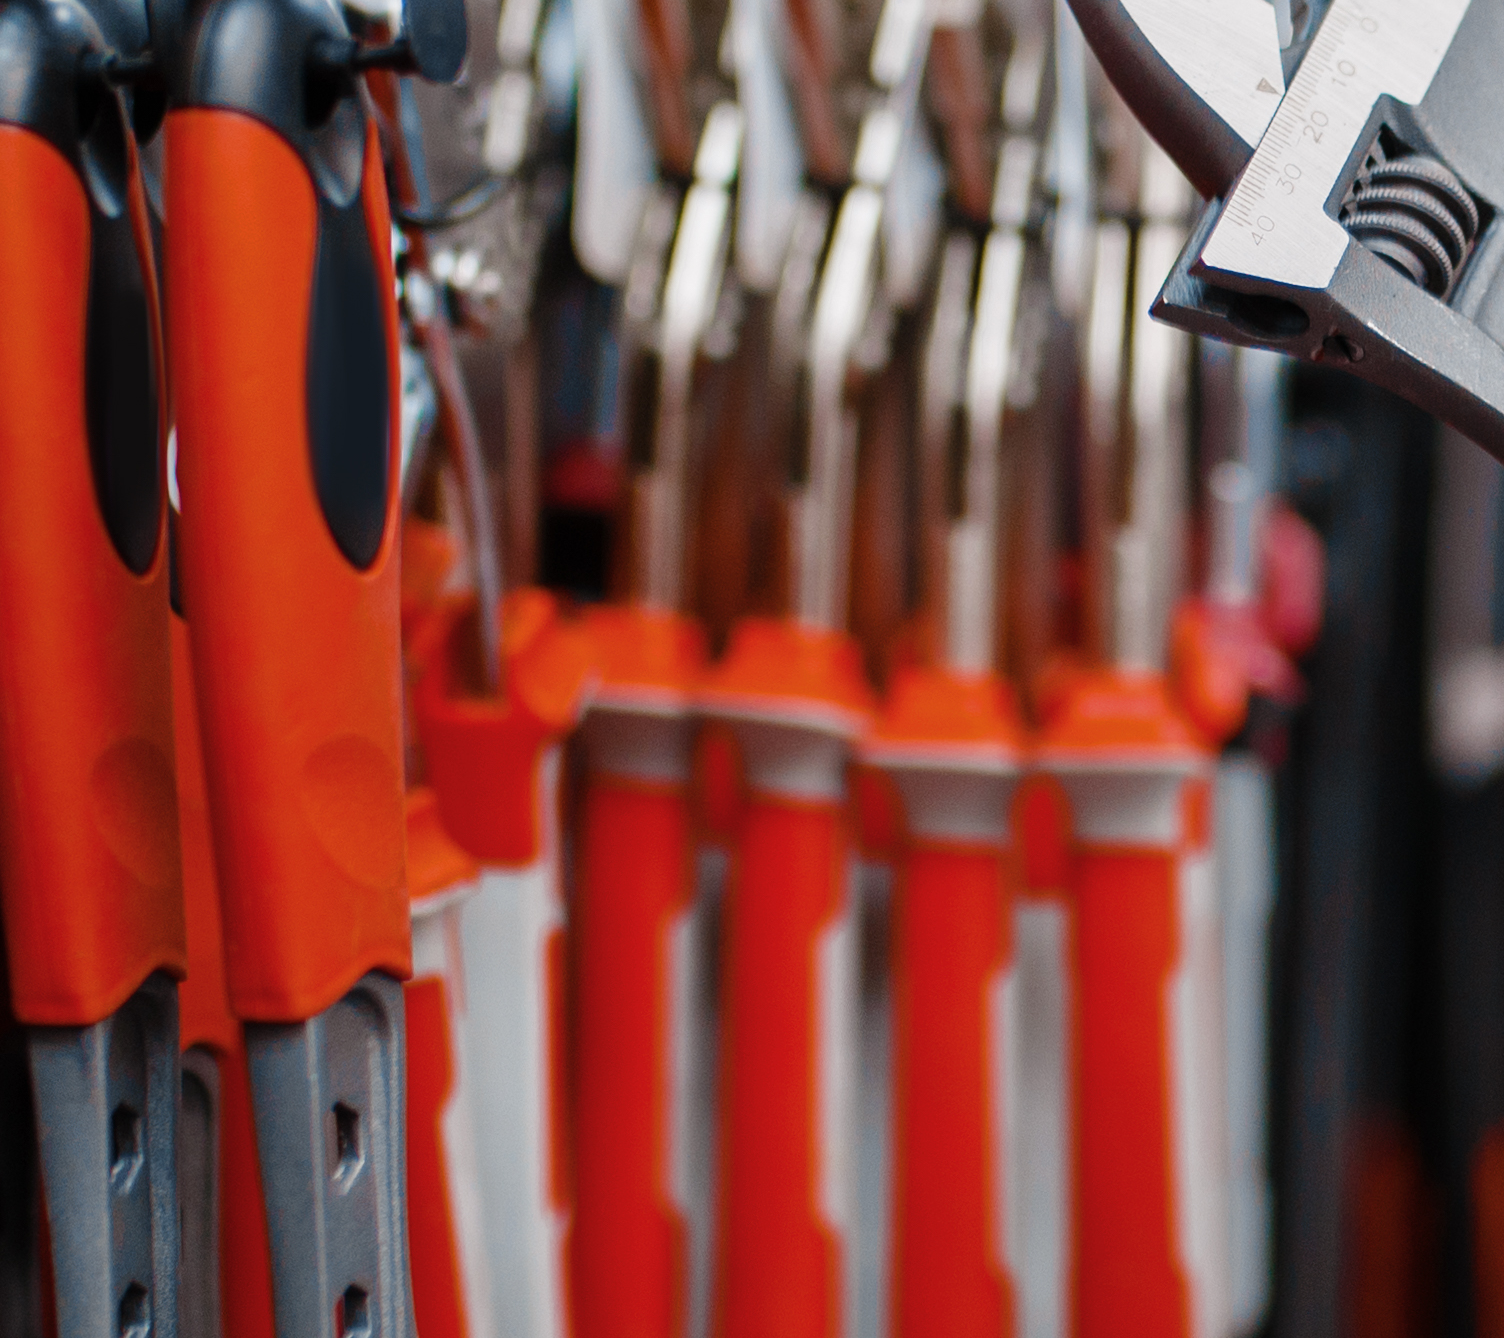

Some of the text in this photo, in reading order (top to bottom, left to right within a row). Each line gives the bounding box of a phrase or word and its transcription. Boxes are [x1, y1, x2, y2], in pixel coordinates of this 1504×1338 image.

[1250, 16, 1378, 246] 40 30 20 10 0
